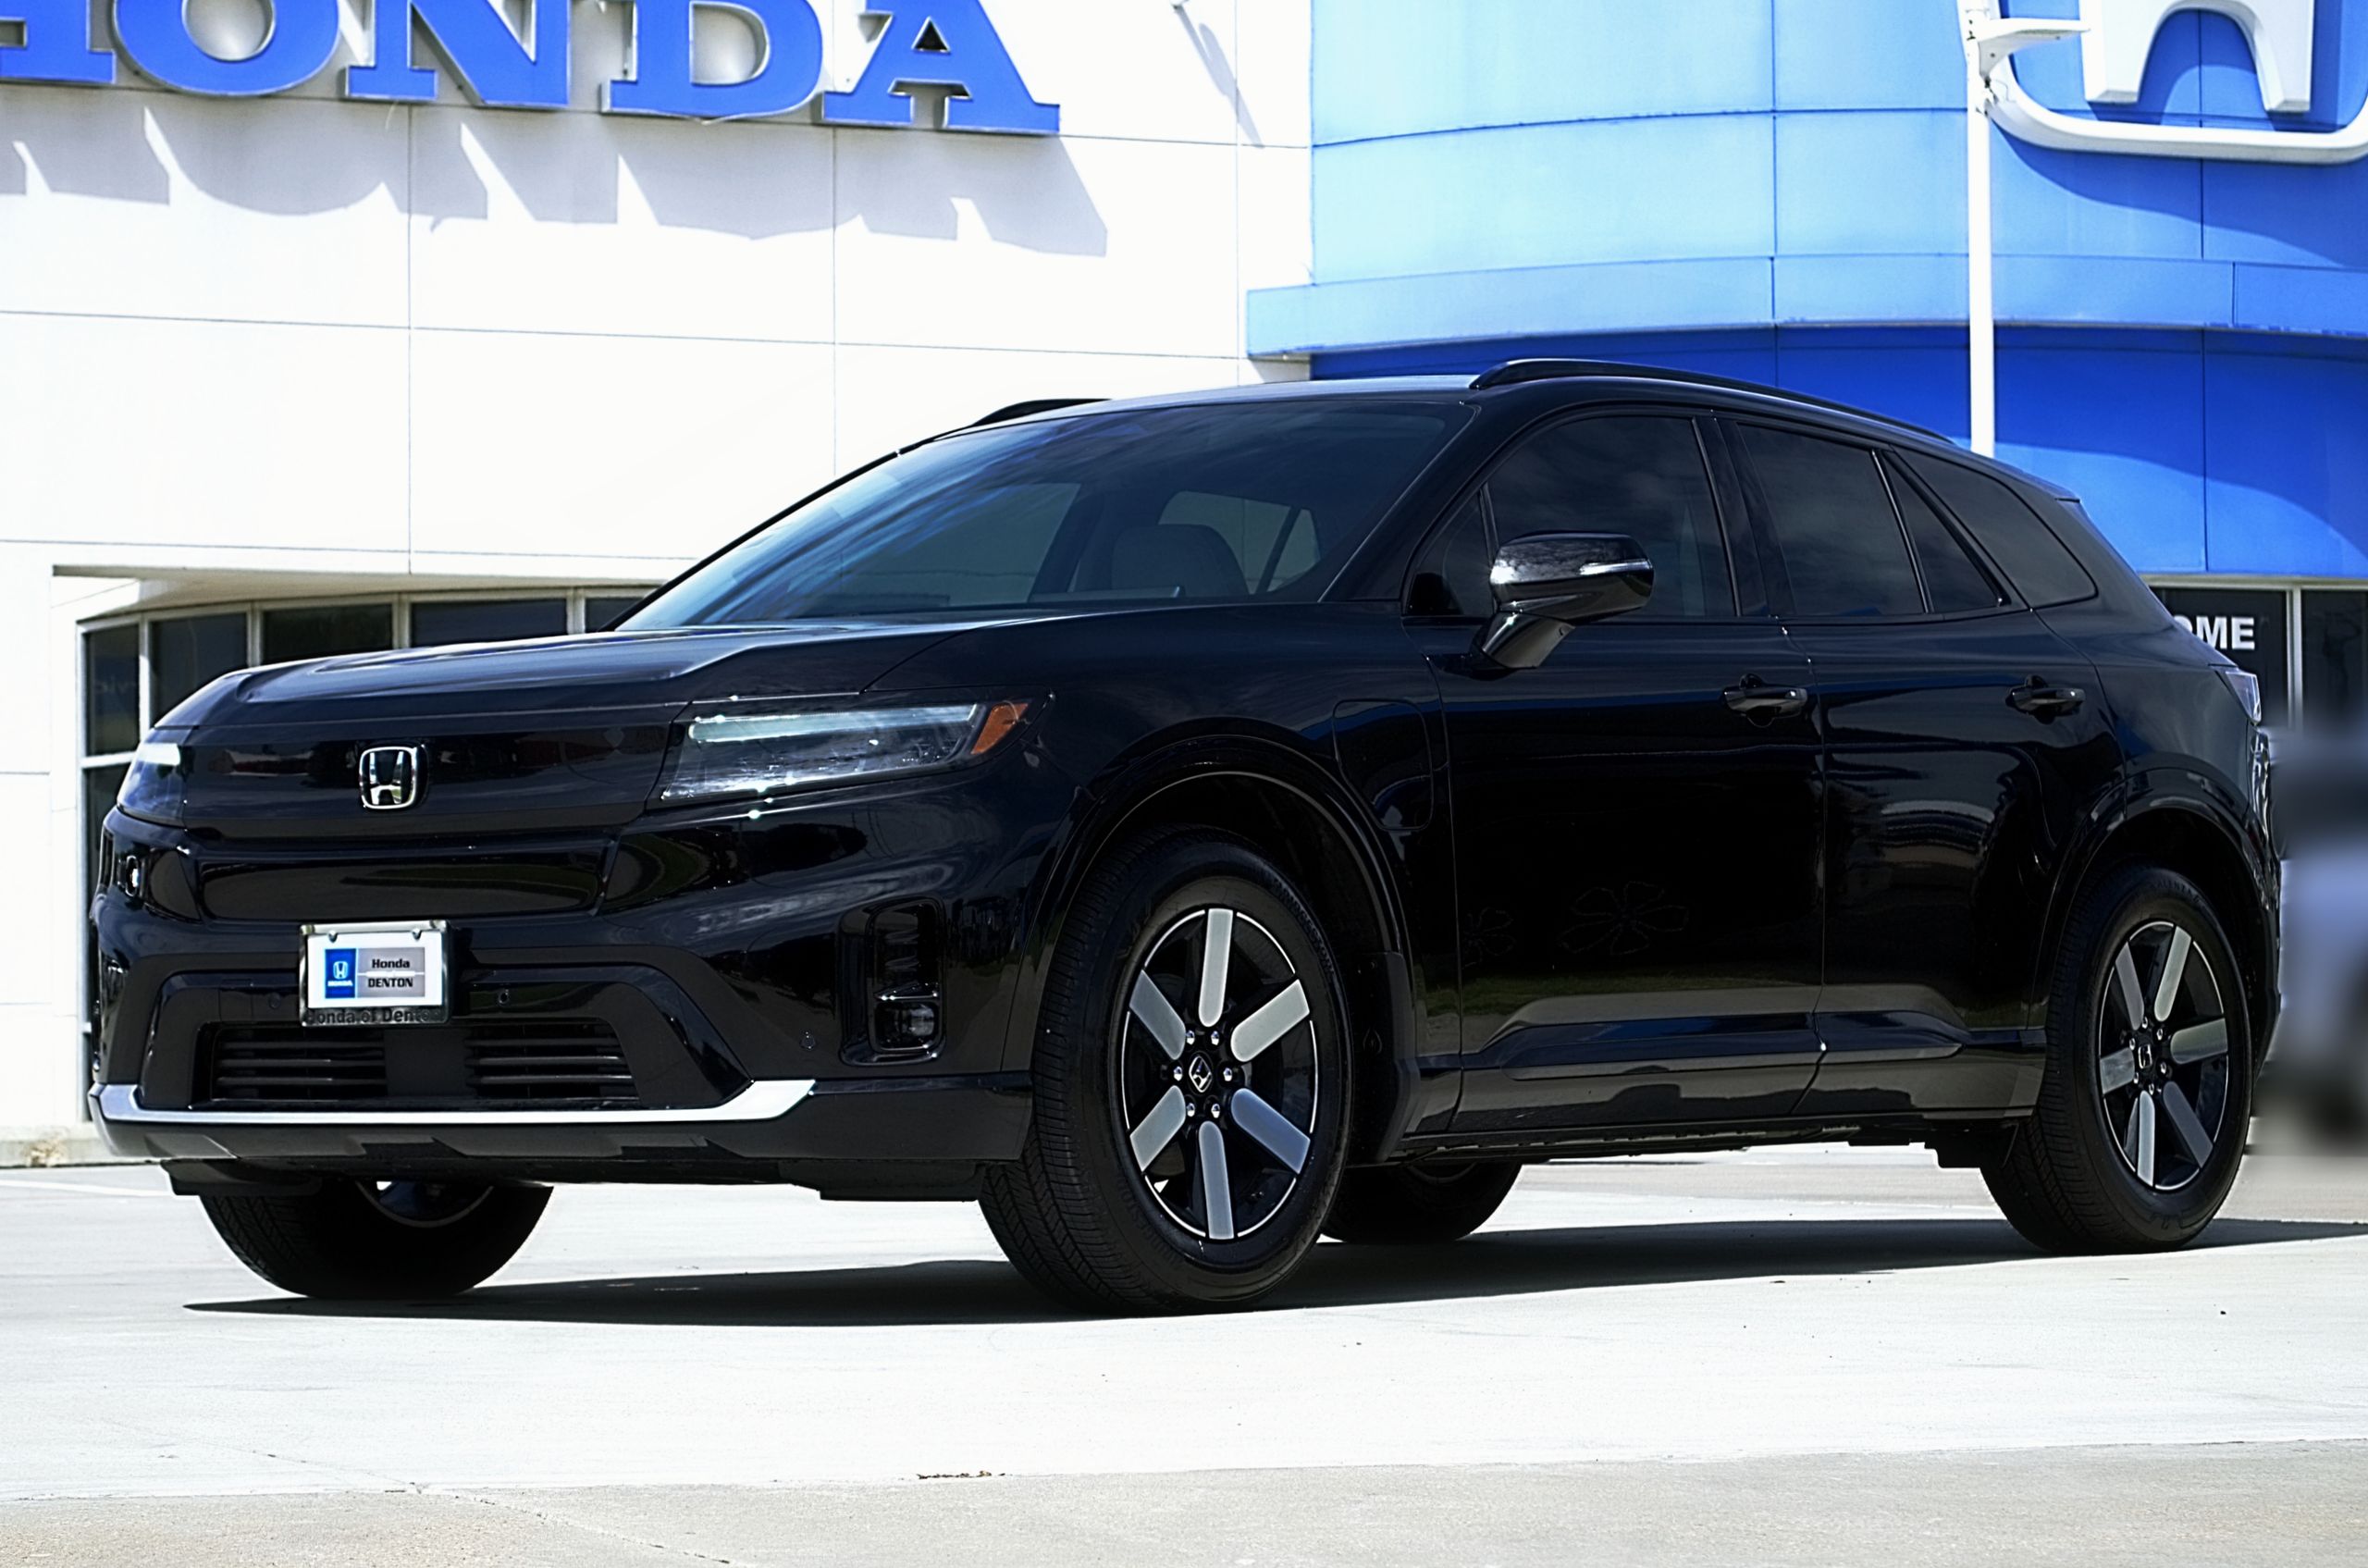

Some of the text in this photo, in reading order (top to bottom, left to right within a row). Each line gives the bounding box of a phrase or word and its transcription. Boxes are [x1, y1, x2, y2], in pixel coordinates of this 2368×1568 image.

[2174, 615, 2256, 649] ME
[372, 958, 410, 969] Honda
[367, 978, 413, 988] DENTON
